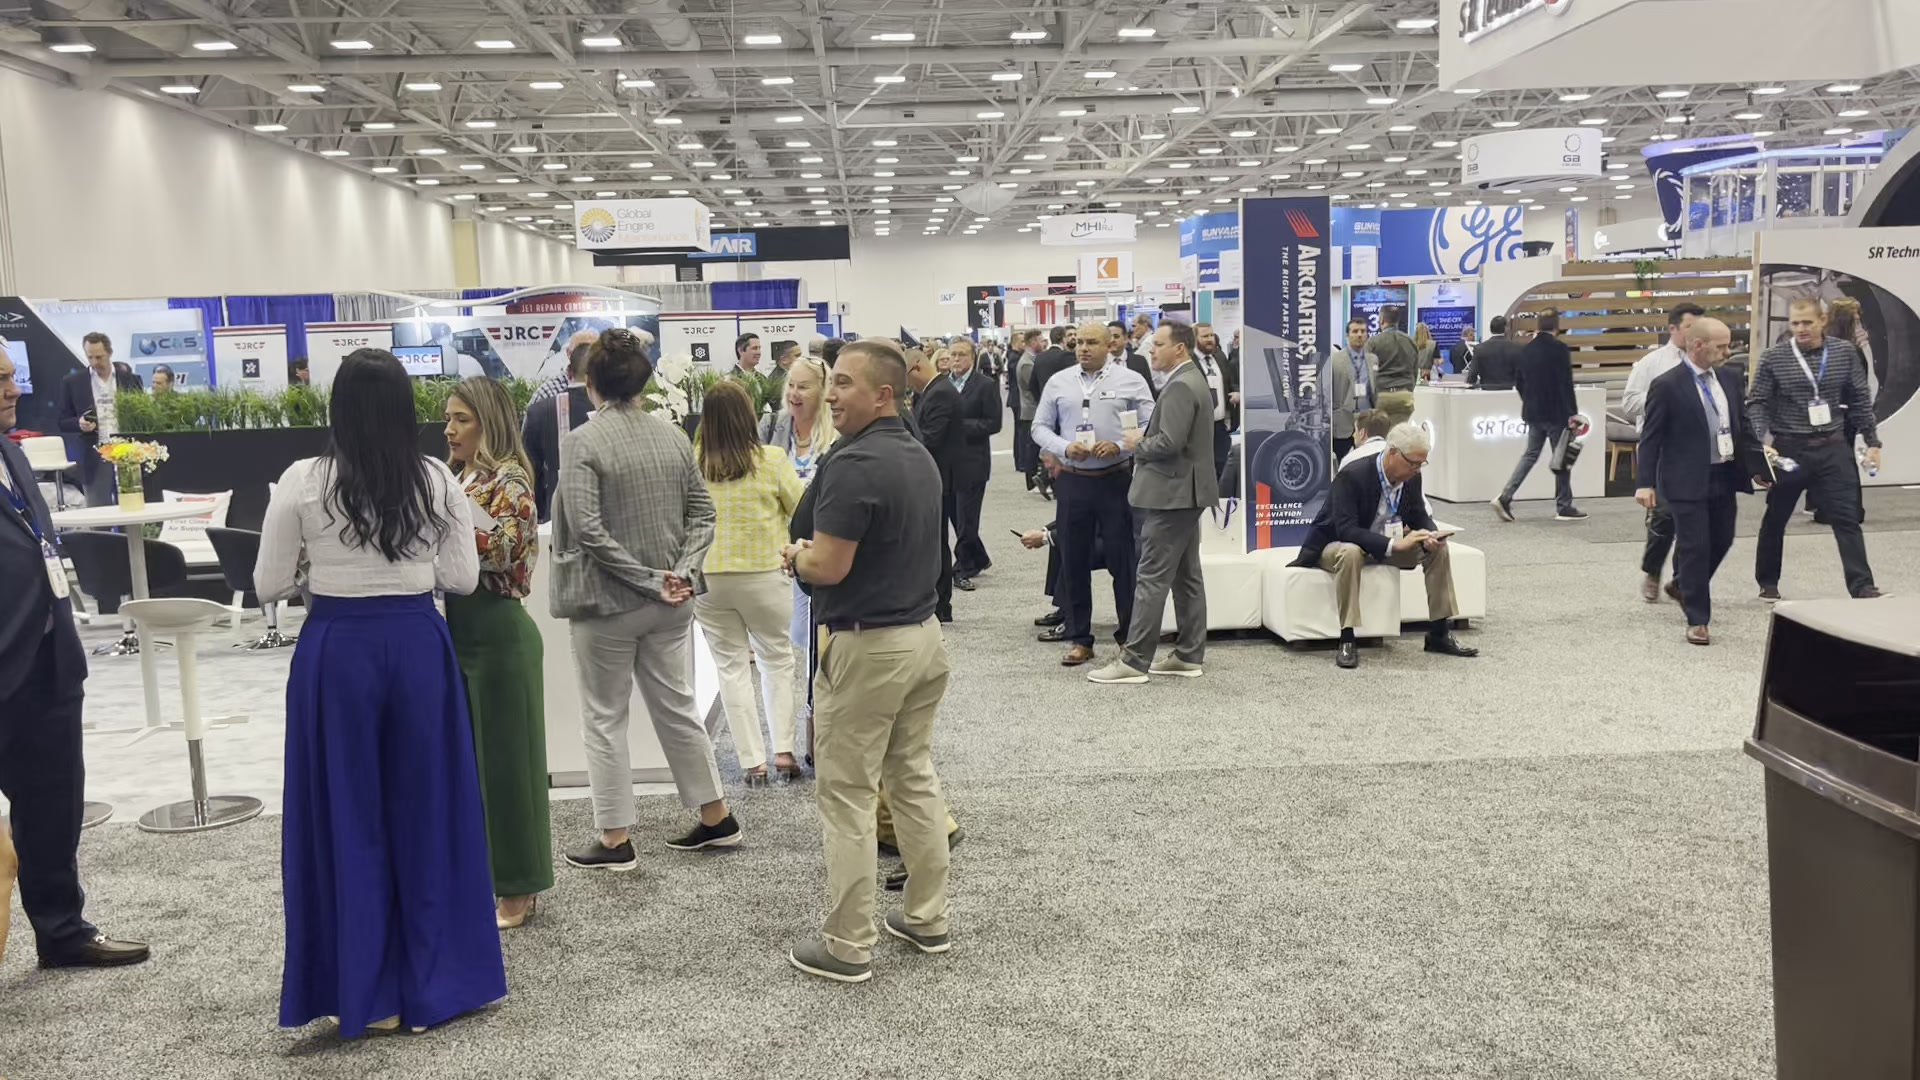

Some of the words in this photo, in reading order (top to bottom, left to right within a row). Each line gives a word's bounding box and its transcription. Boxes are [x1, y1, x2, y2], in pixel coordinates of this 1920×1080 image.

[617, 208, 652, 219] Global
[618, 220, 655, 233] Engine
[1281, 246, 1289, 265] THE
[1868, 246, 1885, 259] SR
[1886, 245, 1920, 259] Techn
[1281, 268, 1289, 300] RIGHT
[535, 303, 562, 312] REPAIR
[1296, 243, 1321, 361] AIRCRAFTERS,
[1281, 303, 1289, 337] PARTS,
[1368, 314, 1379, 331] 3
[503, 326, 540, 341] JRC
[690, 326, 709, 335] JRC
[770, 325, 788, 333] JRC
[241, 342, 259, 350] JRC
[340, 338, 361, 346] JRC
[405, 354, 430, 364] JRC
[1282, 374, 1290, 400] NOW
[1298, 363, 1317, 400] INC.
[1475, 420, 1496, 435] SR
[1256, 502, 1303, 510] EXCELLENCE
